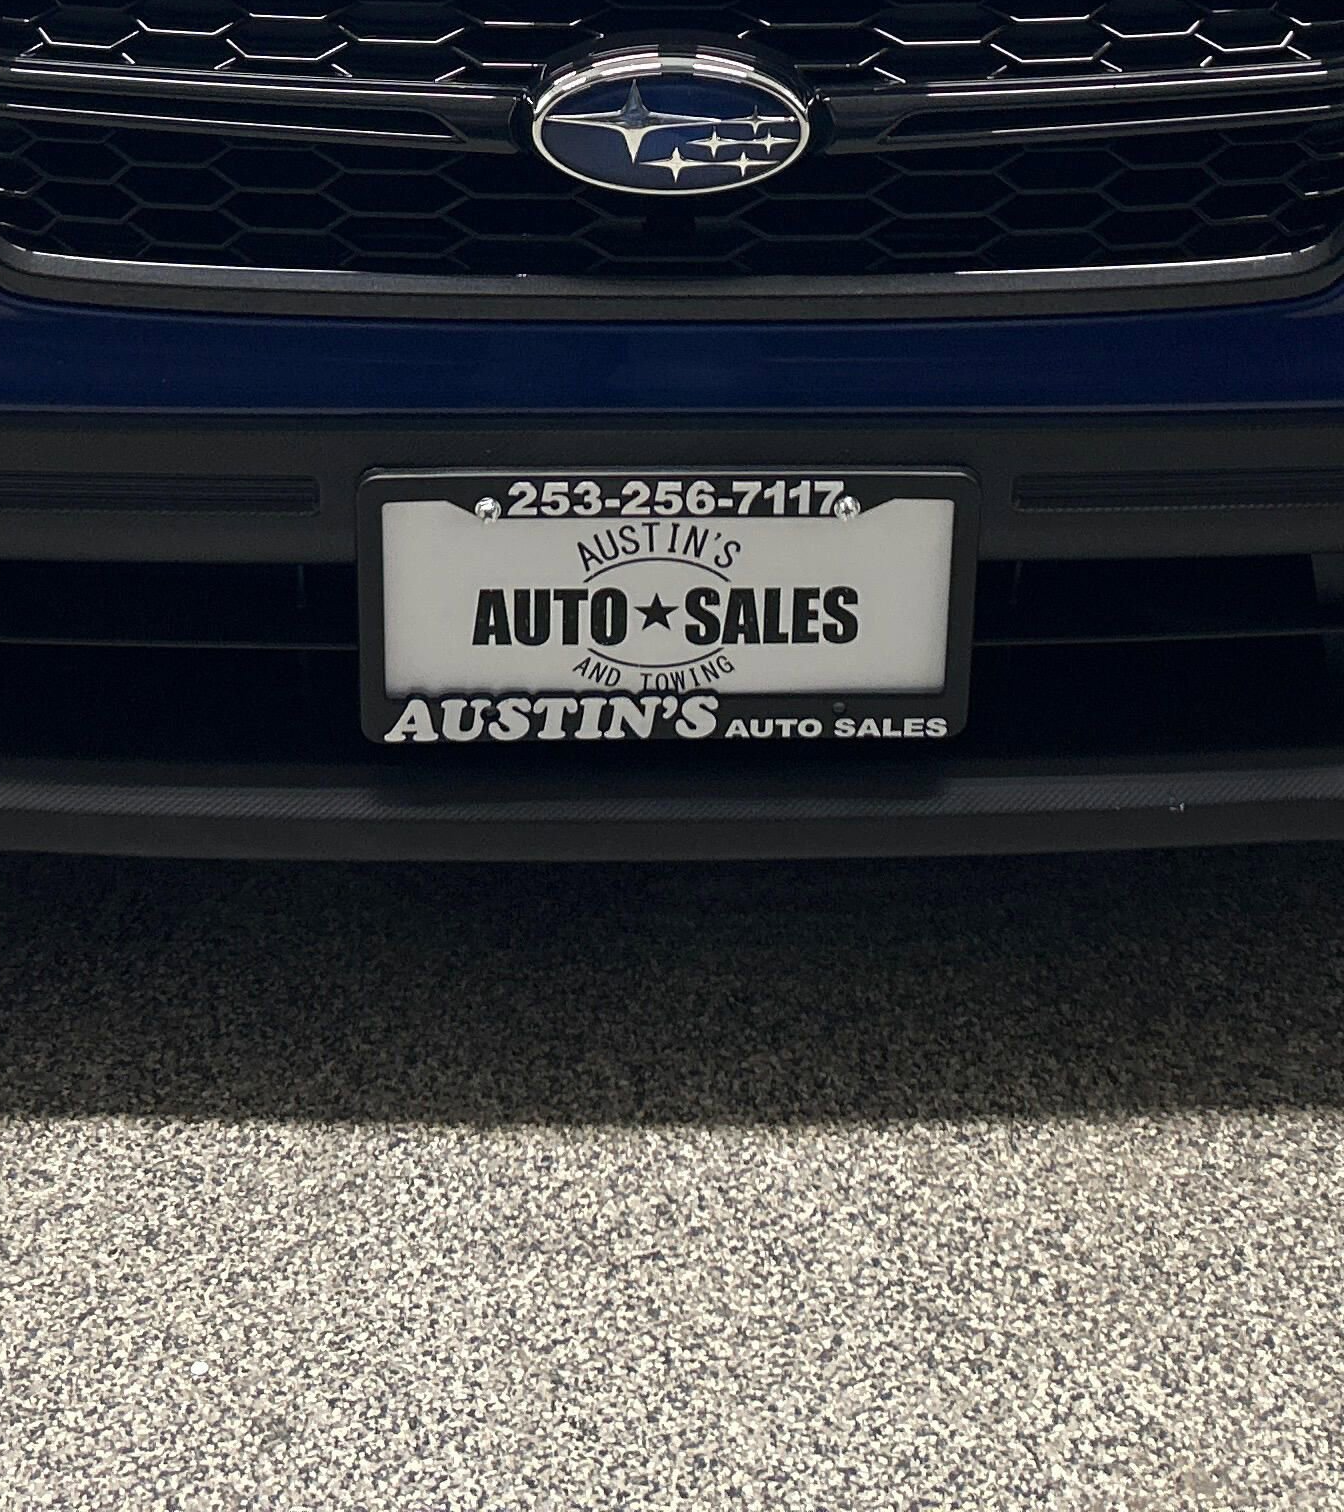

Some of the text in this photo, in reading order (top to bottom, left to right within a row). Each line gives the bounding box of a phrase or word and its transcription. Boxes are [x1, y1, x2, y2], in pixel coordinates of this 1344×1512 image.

[506, 481, 846, 517] 253-256-7117
[576, 521, 742, 573] AUSTIN'S
[471, 586, 859, 647] AUTO SALES
[572, 653, 737, 692] AND TOWING
[383, 694, 949, 742] AUSTIN'S AUTO SALES
